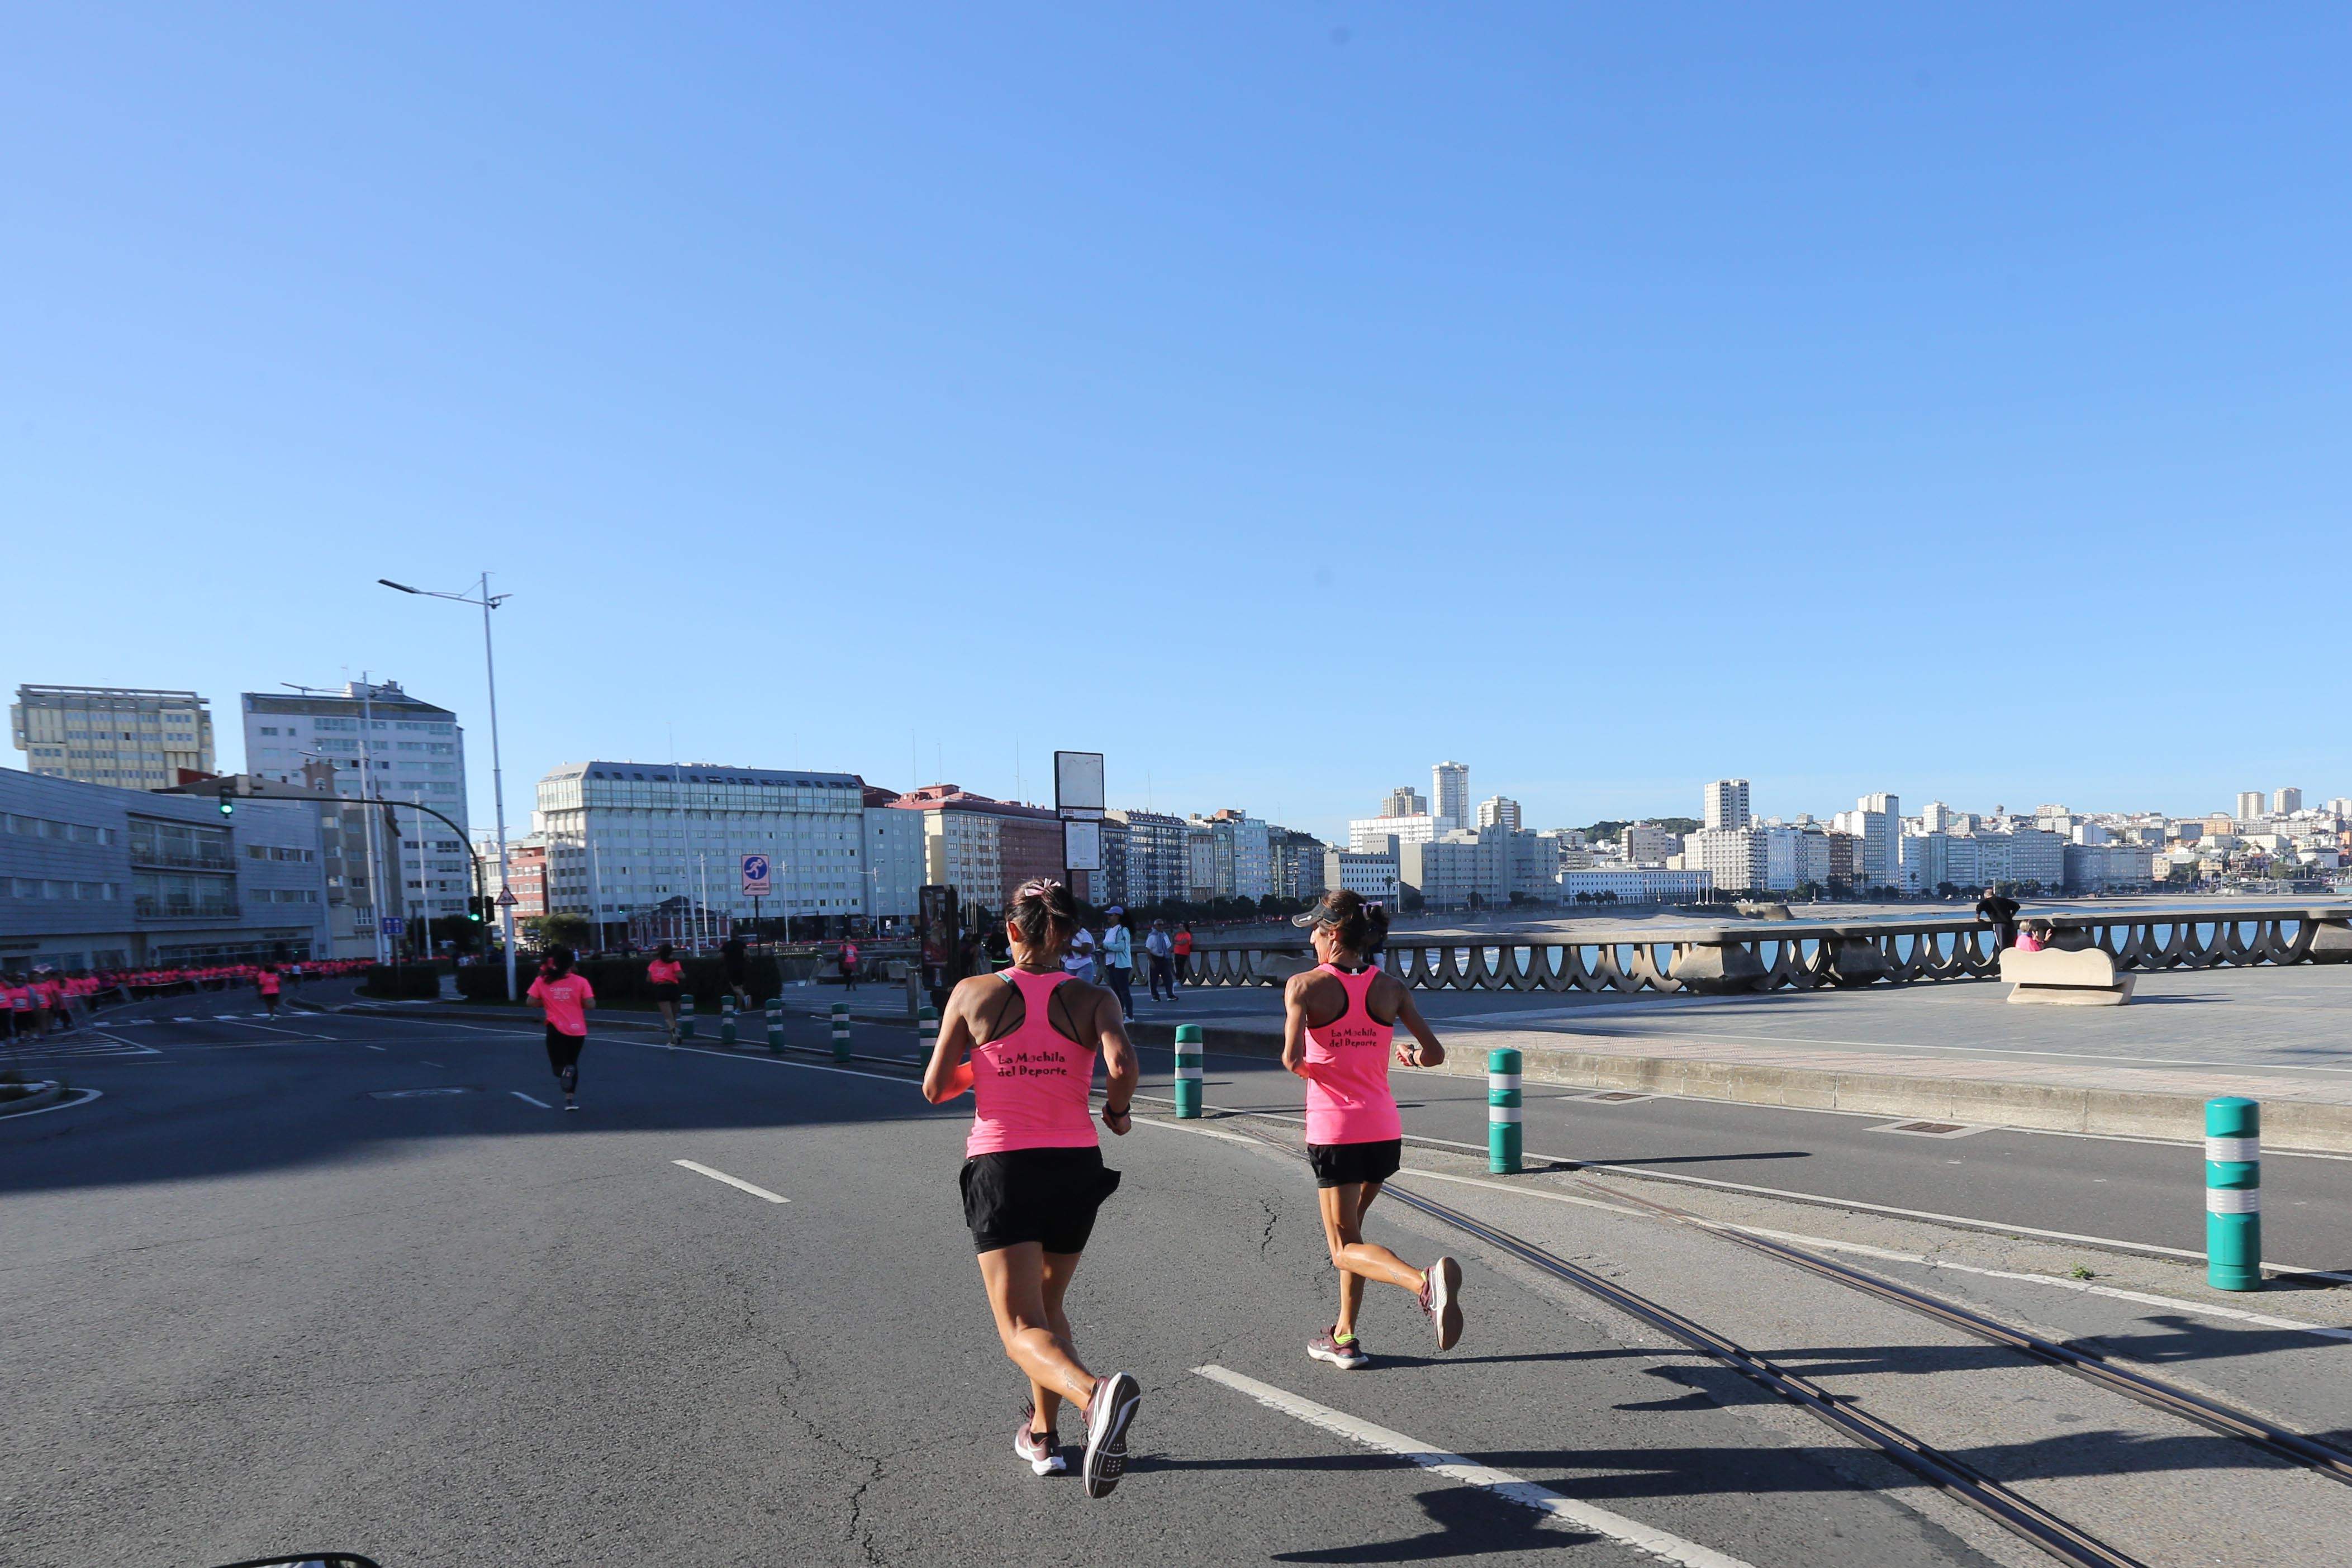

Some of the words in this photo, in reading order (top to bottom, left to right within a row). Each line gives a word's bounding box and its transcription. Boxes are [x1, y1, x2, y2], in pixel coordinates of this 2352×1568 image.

[1329, 1038, 1343, 1048] del
[1345, 1038, 1377, 1048] Deporte
[998, 1054, 1014, 1065] La
[997, 1066, 1016, 1077] del
[1019, 1065, 1067, 1078] Deporte
